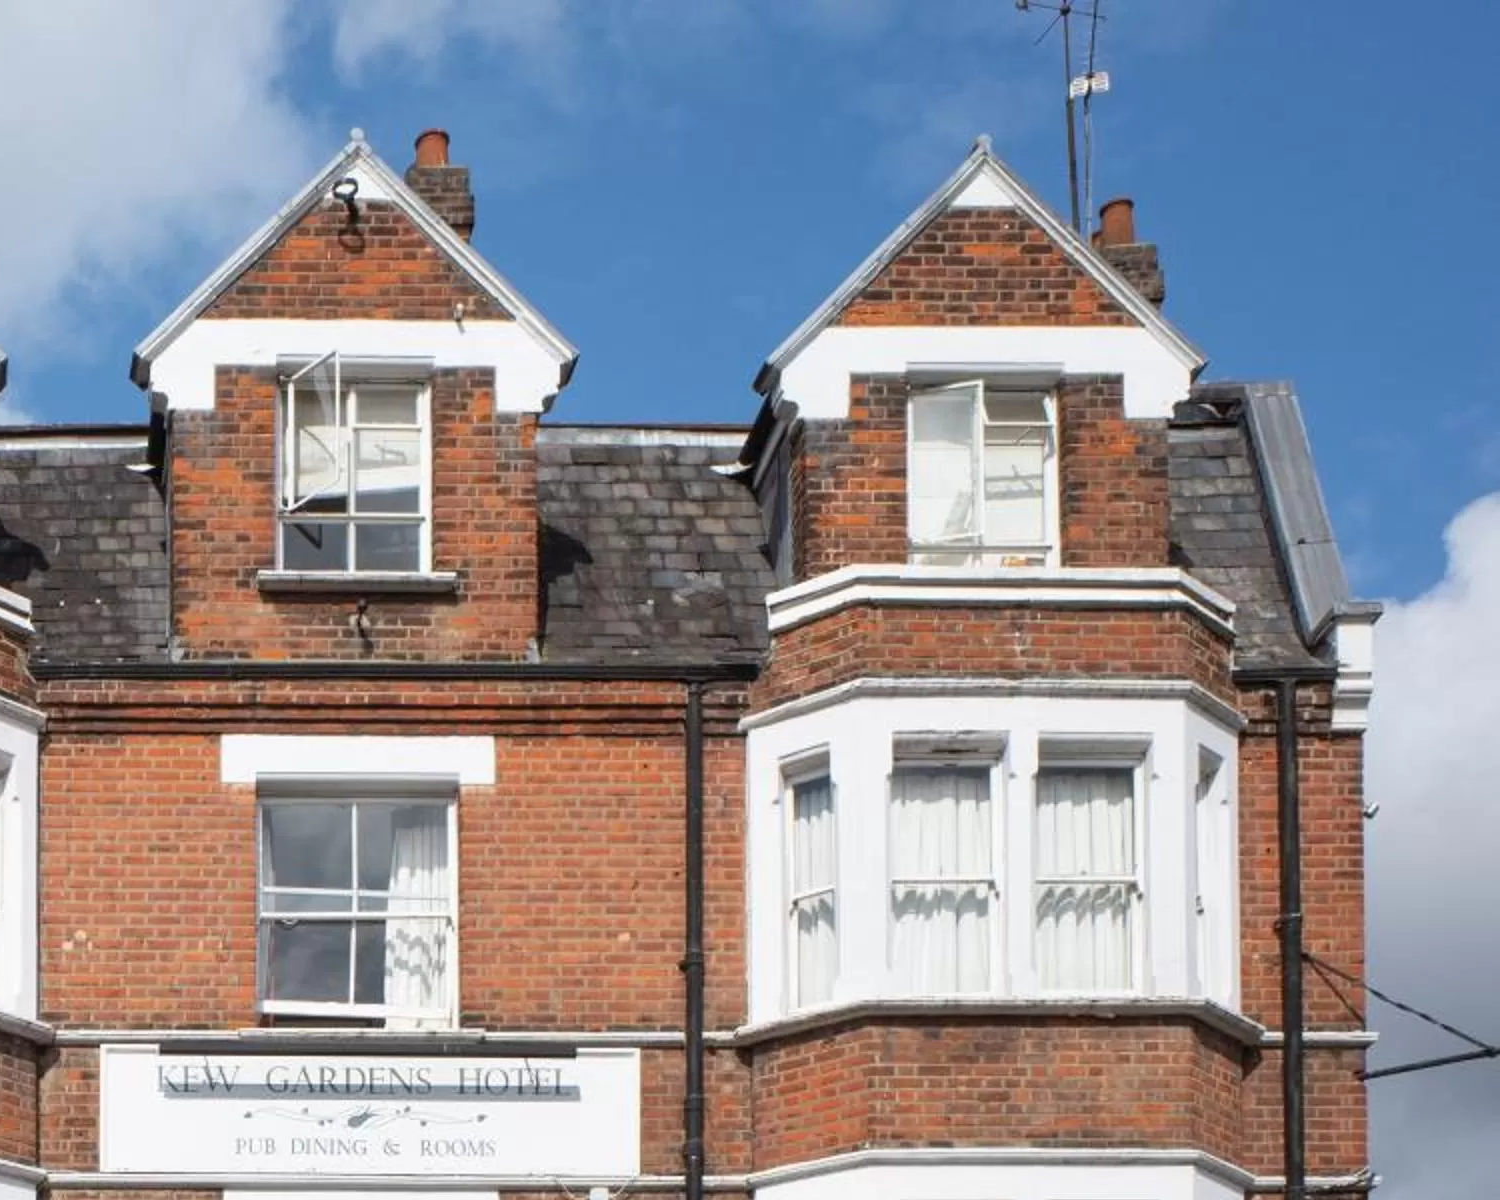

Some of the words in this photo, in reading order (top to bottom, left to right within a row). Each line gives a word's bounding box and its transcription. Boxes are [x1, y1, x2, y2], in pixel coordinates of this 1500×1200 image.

[157, 1064, 242, 1094] KEW
[265, 1065, 432, 1096] GARDENS
[456, 1066, 573, 1097] HOTEL
[235, 1137, 276, 1156] PUB
[291, 1138, 368, 1157] DINING
[383, 1139, 401, 1157] &
[420, 1139, 497, 1158] ROOMS
